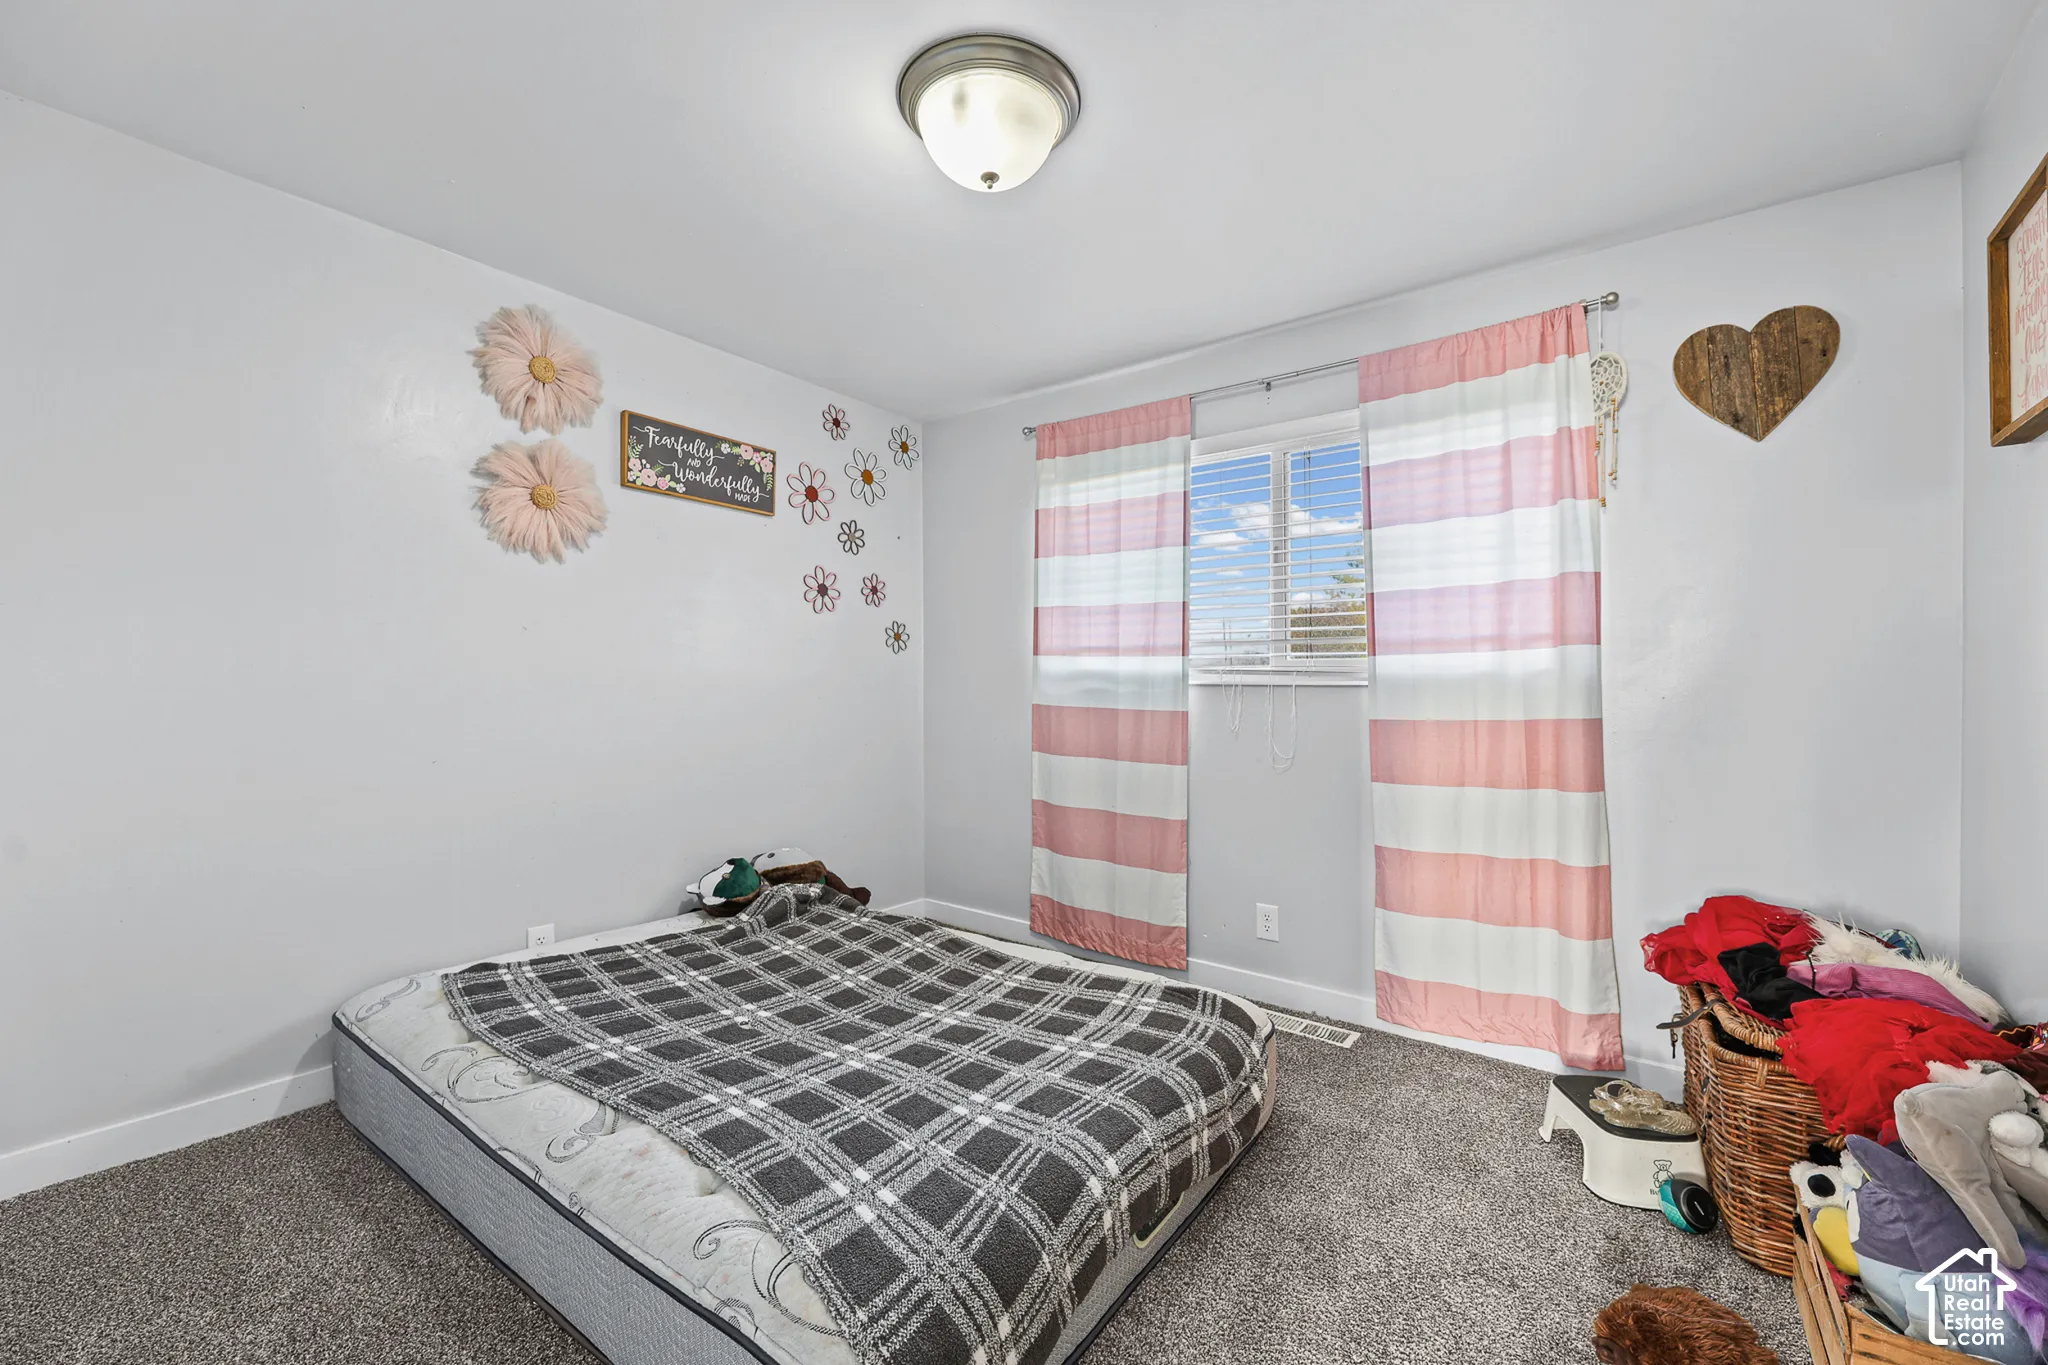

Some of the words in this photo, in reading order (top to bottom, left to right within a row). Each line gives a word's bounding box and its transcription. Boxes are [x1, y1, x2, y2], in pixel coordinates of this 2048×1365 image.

[633, 426, 725, 466] Fearfully
[687, 458, 701, 468] AND
[658, 460, 770, 502] Wonderfully
[735, 492, 751, 503] MADE
